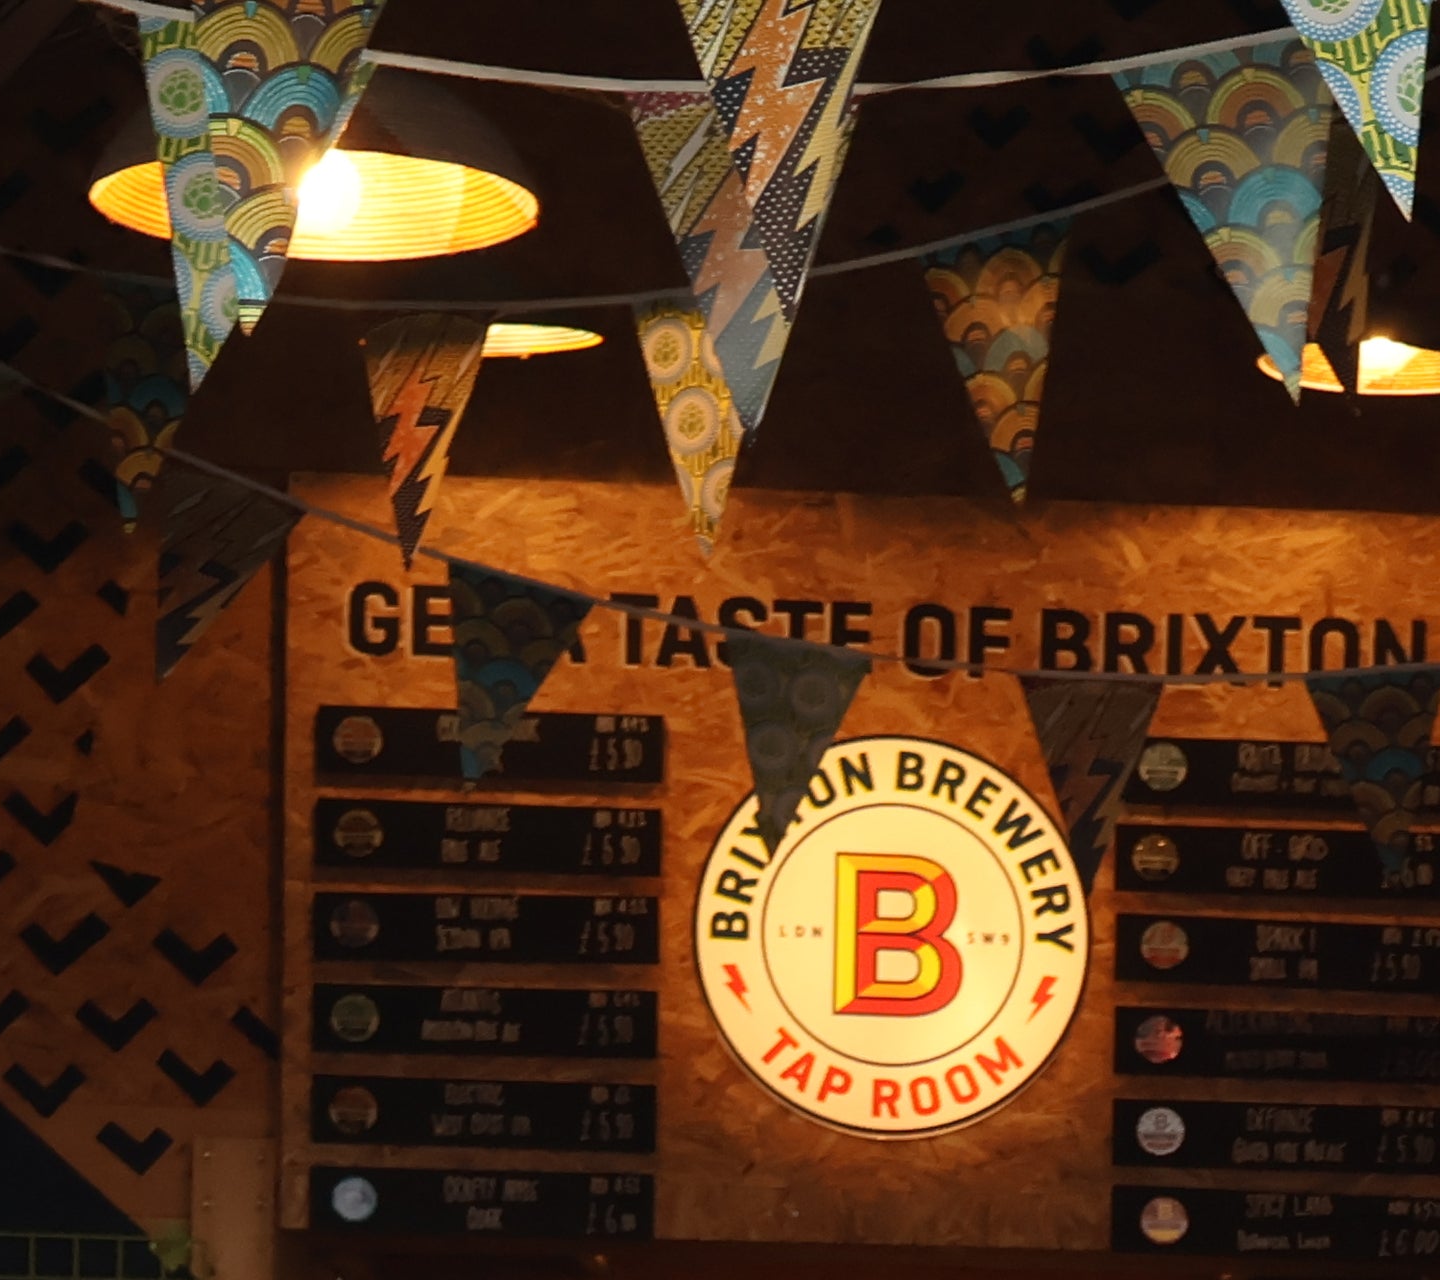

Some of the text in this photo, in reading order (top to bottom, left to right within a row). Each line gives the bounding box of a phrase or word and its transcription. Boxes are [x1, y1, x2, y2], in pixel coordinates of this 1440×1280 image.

[348, 581, 458, 657] GE
[903, 603, 1013, 679] OF
[1039, 608, 1428, 687] BRIXTON
[896, 751, 1076, 954] BREWERY
[833, 852, 963, 1016] B
[760, 1027, 1026, 1119] TAP ROOM
